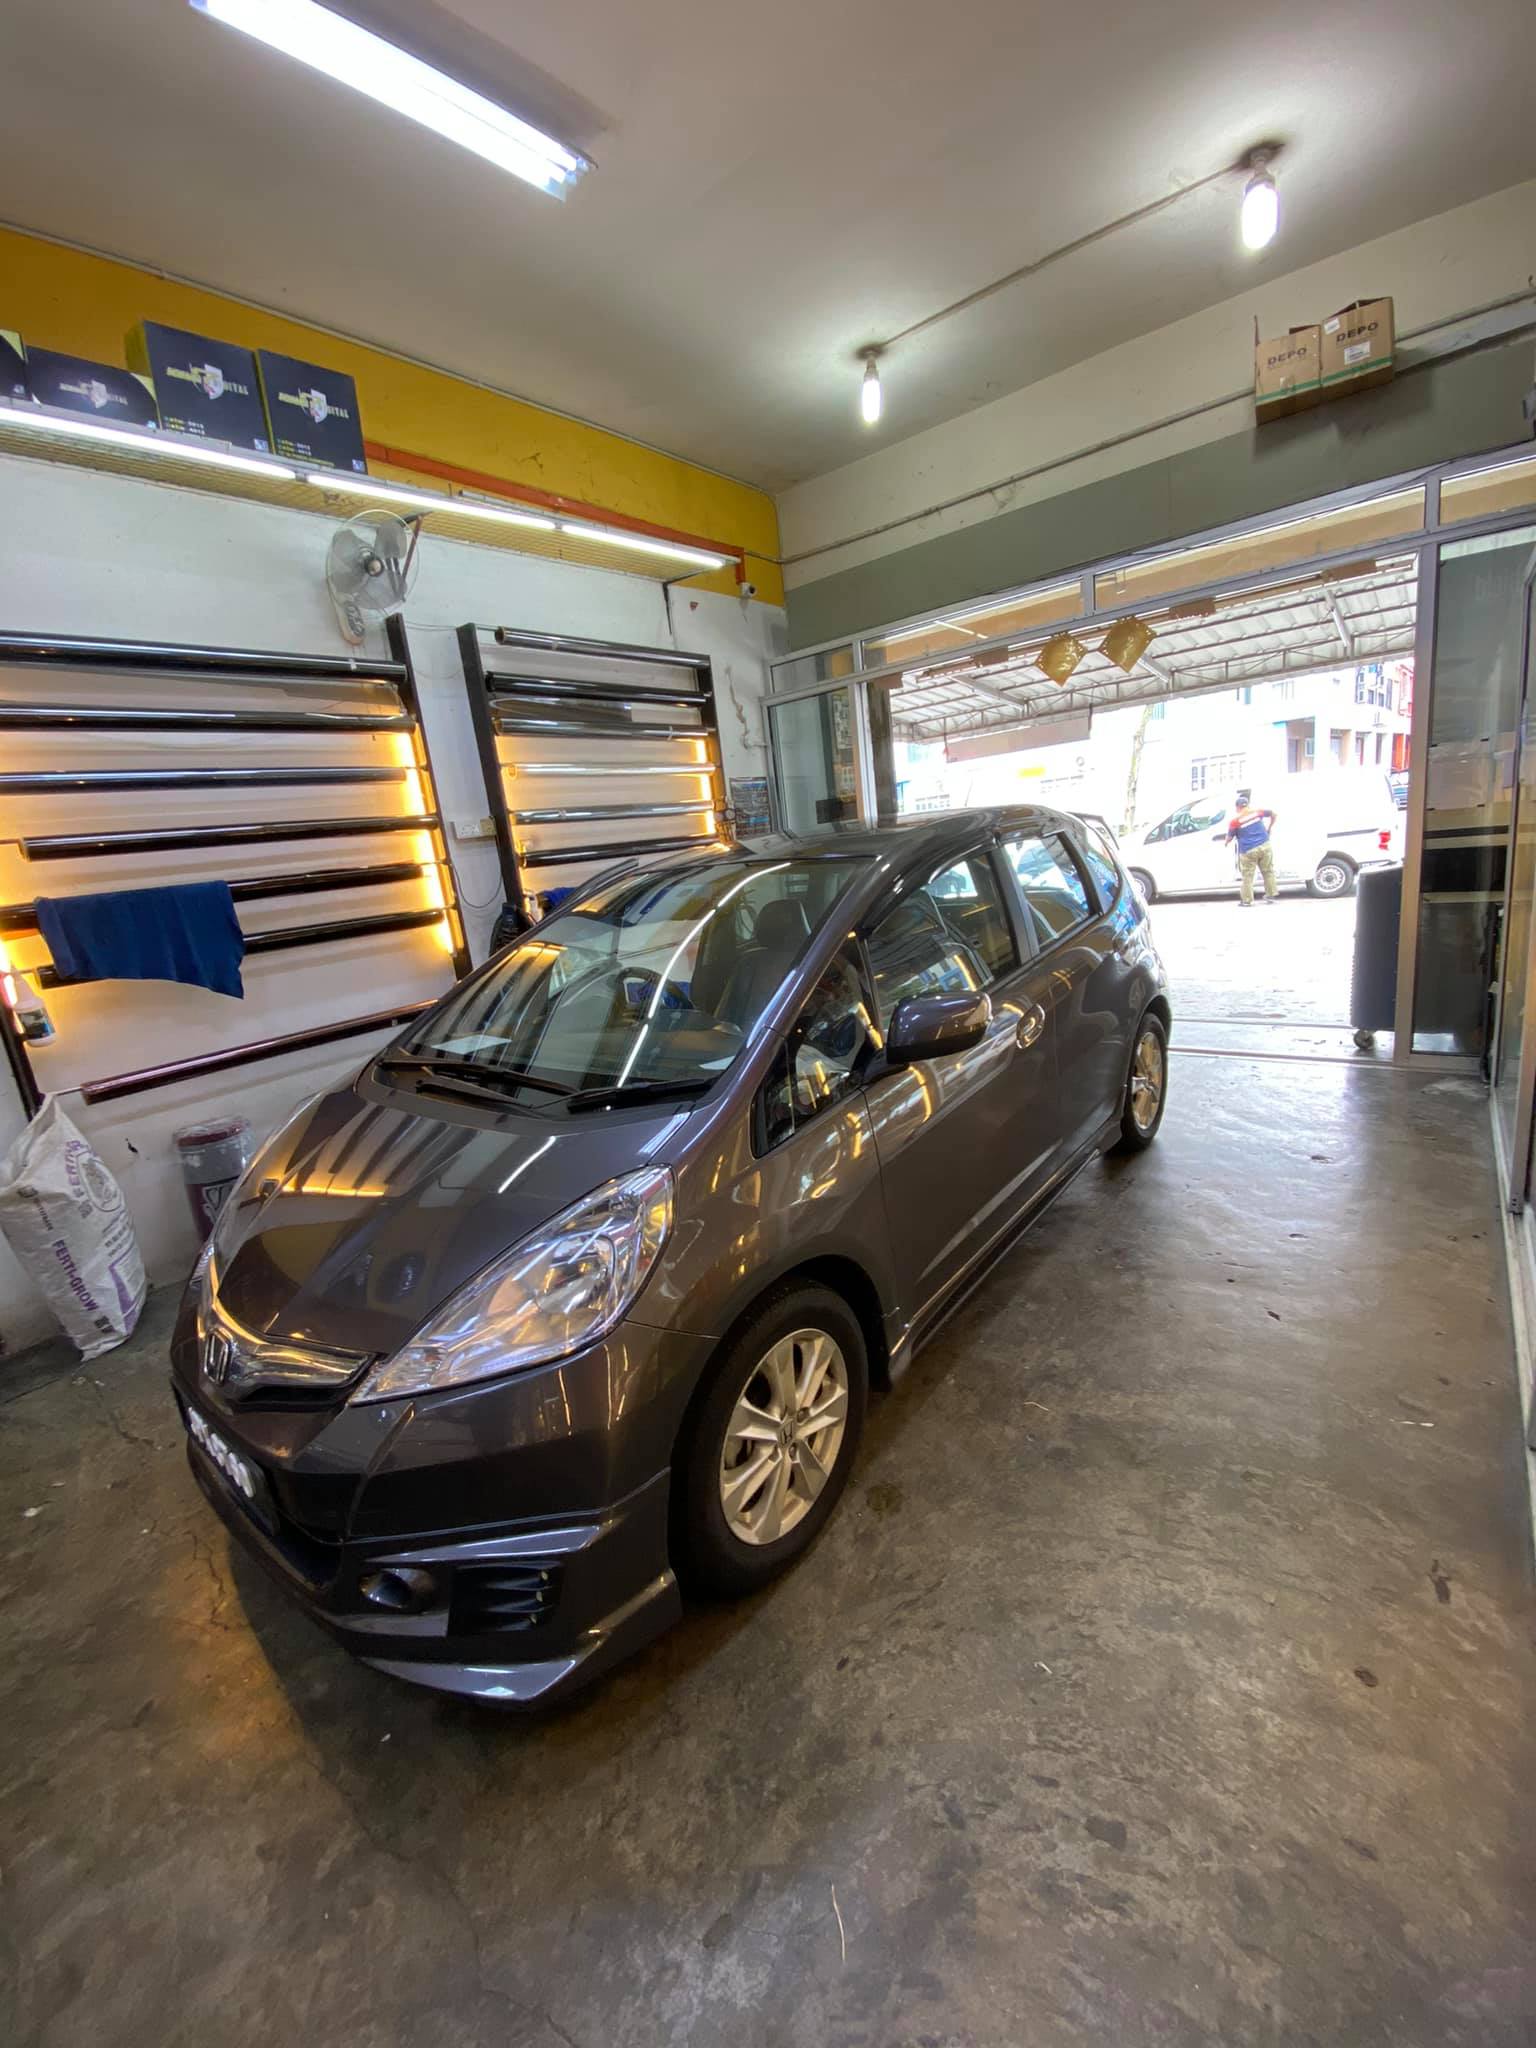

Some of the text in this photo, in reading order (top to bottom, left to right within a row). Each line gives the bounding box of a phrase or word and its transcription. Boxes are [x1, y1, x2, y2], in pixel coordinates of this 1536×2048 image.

[1336, 322, 1378, 342] DEPO
[1268, 347, 1306, 365] DEPO
[53, 1240, 98, 1311] FERTI-GROW
